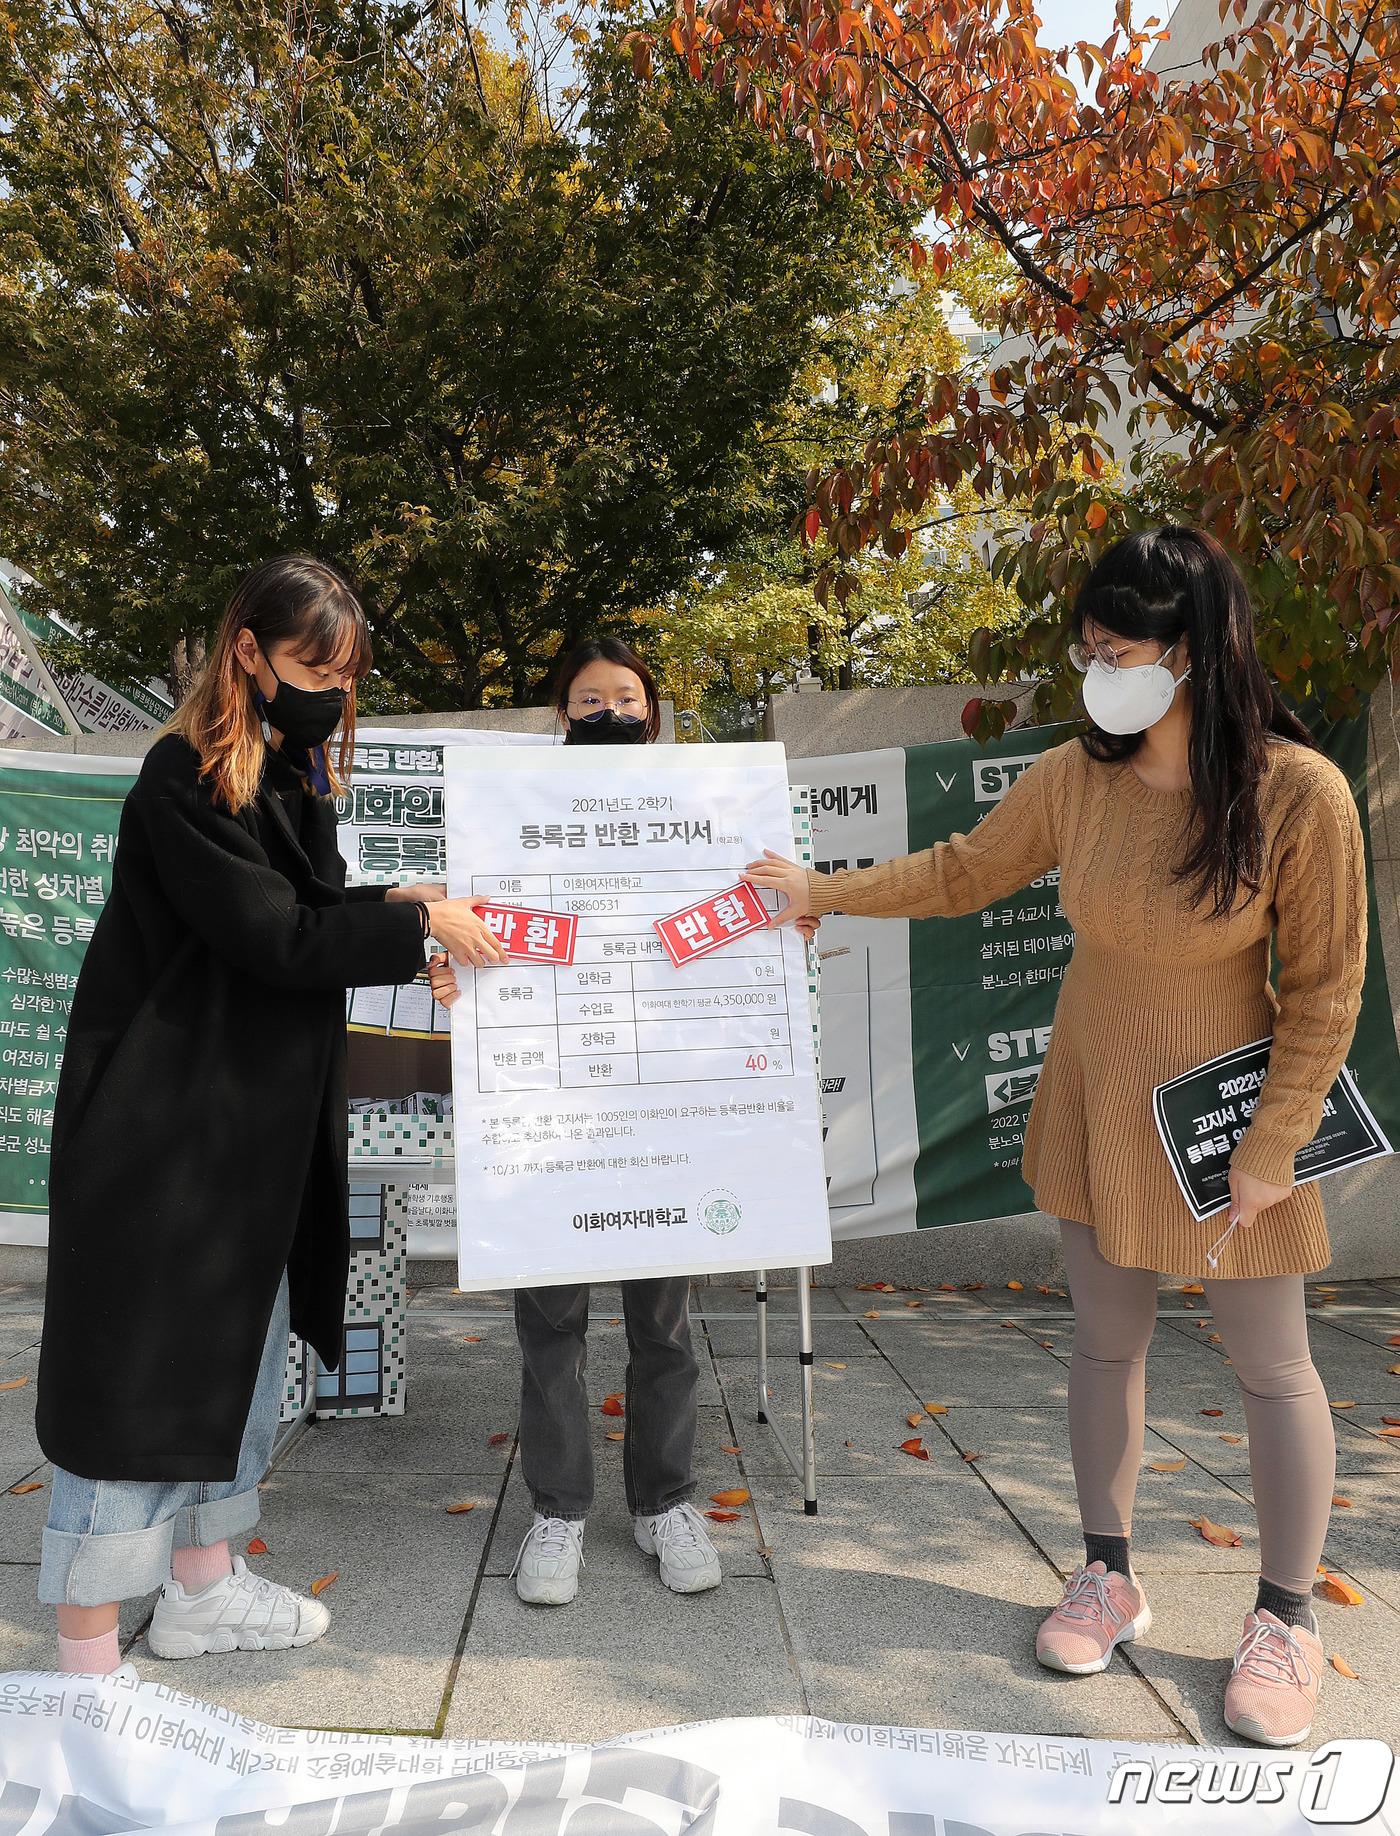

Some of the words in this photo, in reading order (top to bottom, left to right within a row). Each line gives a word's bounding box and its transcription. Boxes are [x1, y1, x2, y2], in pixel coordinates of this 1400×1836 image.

[395, 749, 443, 772] 반환,
[571, 798, 634, 813] 2021년도
[637, 796, 674, 811] 2학기
[519, 823, 588, 849] 등록금
[594, 822, 640, 847] 반환
[646, 820, 712, 845] 고지서
[716, 835, 743, 845] (학교용)
[15, 828, 82, 860] 최악의
[90, 833, 118, 863] 취
[361, 834, 446, 872] 등록
[33, 873, 105, 904] 성차별
[499, 880, 522, 893] 이름
[563, 876, 643, 891] 이화여자대학교
[564, 898, 619, 912] 18860531
[0, 907, 46, 940] 높은
[981, 909, 1014, 928] 월-금
[1017, 905, 1050, 922] 4교시
[602, 943, 637, 956] 등록금
[640, 940, 663, 954] 내역
[980, 940, 1020, 960] 설치된
[1, 966, 42, 986] 수많은
[577, 971, 612, 986] 입학금
[765, 965, 775, 977] 원
[981, 971, 1022, 990] 분노의
[498, 986, 534, 1001] 등록금
[642, 1000, 671, 1010] 이화여대
[673, 998, 695, 1009] 한학기
[697, 998, 712, 1008] 평균
[713, 993, 764, 1008] 4,350,000
[767, 993, 777, 1005] 원
[10, 994, 55, 1013] 심각한
[579, 1002, 614, 1017] 수업료
[36, 1023, 50, 1041] 쉴
[580, 1032, 616, 1047] 장학금
[770, 1027, 780, 1040] 원
[2, 1049, 49, 1069] 여전히
[493, 1052, 517, 1067] 반환
[520, 1051, 545, 1065] 금액
[745, 1053, 767, 1071] 40
[772, 1060, 783, 1070] %
[588, 1063, 612, 1078] 반환
[489, 1118, 499, 1130] 본
[556, 1112, 593, 1125] 고지서는
[596, 1109, 637, 1122] 1005인의
[640, 1107, 677, 1120] 이화인이
[680, 1105, 717, 1118] 요구하는
[719, 1102, 765, 1115] 등록금반환
[768, 1100, 795, 1112] 비율을
[1192, 1105, 1238, 1136] 고지서
[988, 1132, 1025, 1150] 분노의
[1186, 1134, 1231, 1165] 등록금
[492, 1164, 519, 1177] 10/31
[523, 1162, 543, 1175] 까지
[545, 1160, 574, 1173] 등록금
[576, 1158, 606, 1172] 반환에
[608, 1156, 627, 1169] 대한
[630, 1155, 649, 1168] 회신
[651, 1152, 692, 1166] 바랍니다.
[572, 1207, 688, 1232] 이화여자대학교
